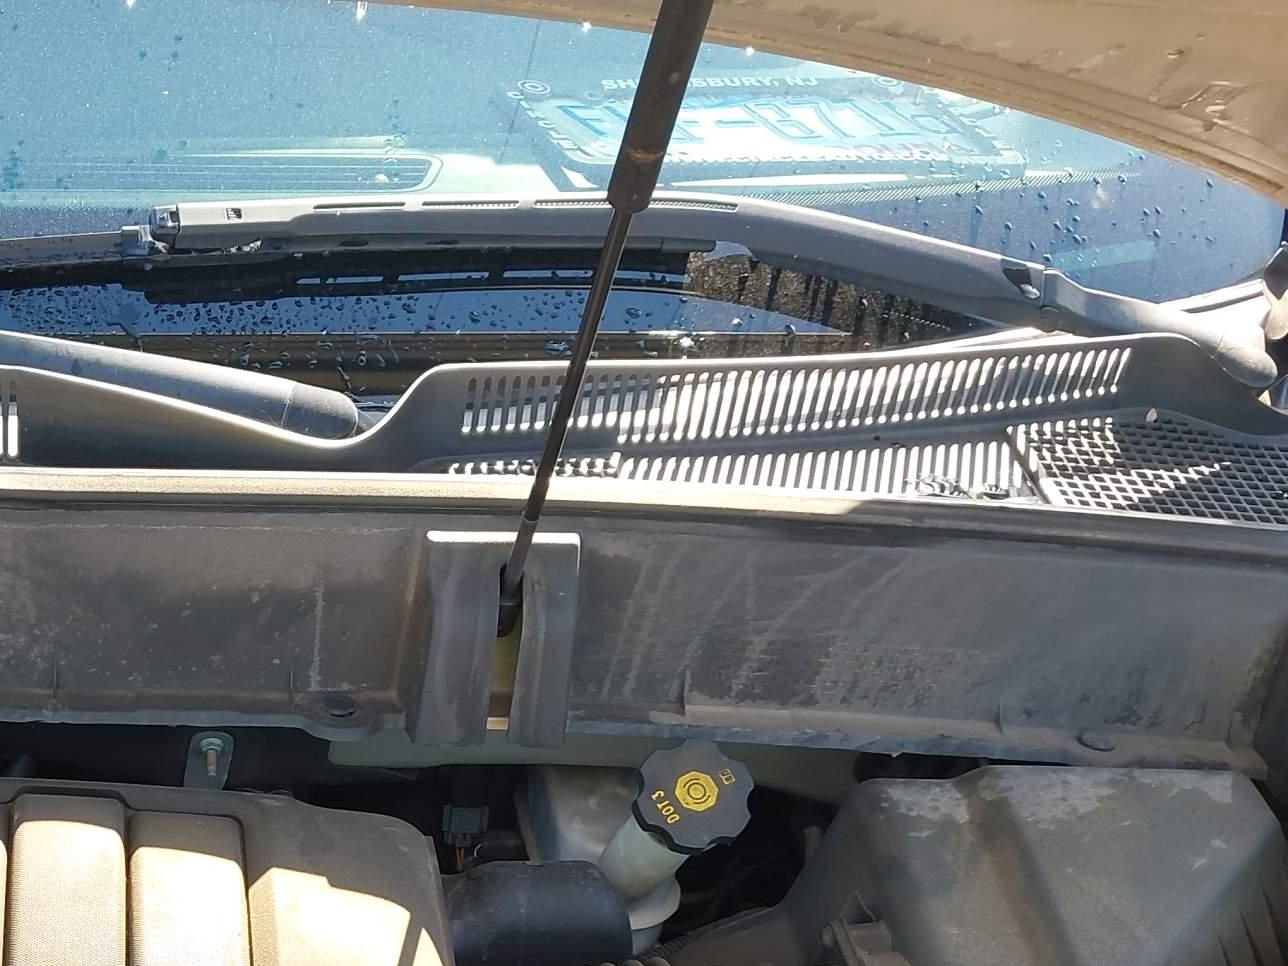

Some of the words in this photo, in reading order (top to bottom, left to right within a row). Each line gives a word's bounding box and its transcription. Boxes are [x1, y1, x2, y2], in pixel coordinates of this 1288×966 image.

[601, 78, 779, 90] SHSBURY,
[783, 76, 818, 88] NJ
[651, 790, 665, 801] 3
[656, 800, 681, 824] DOT
